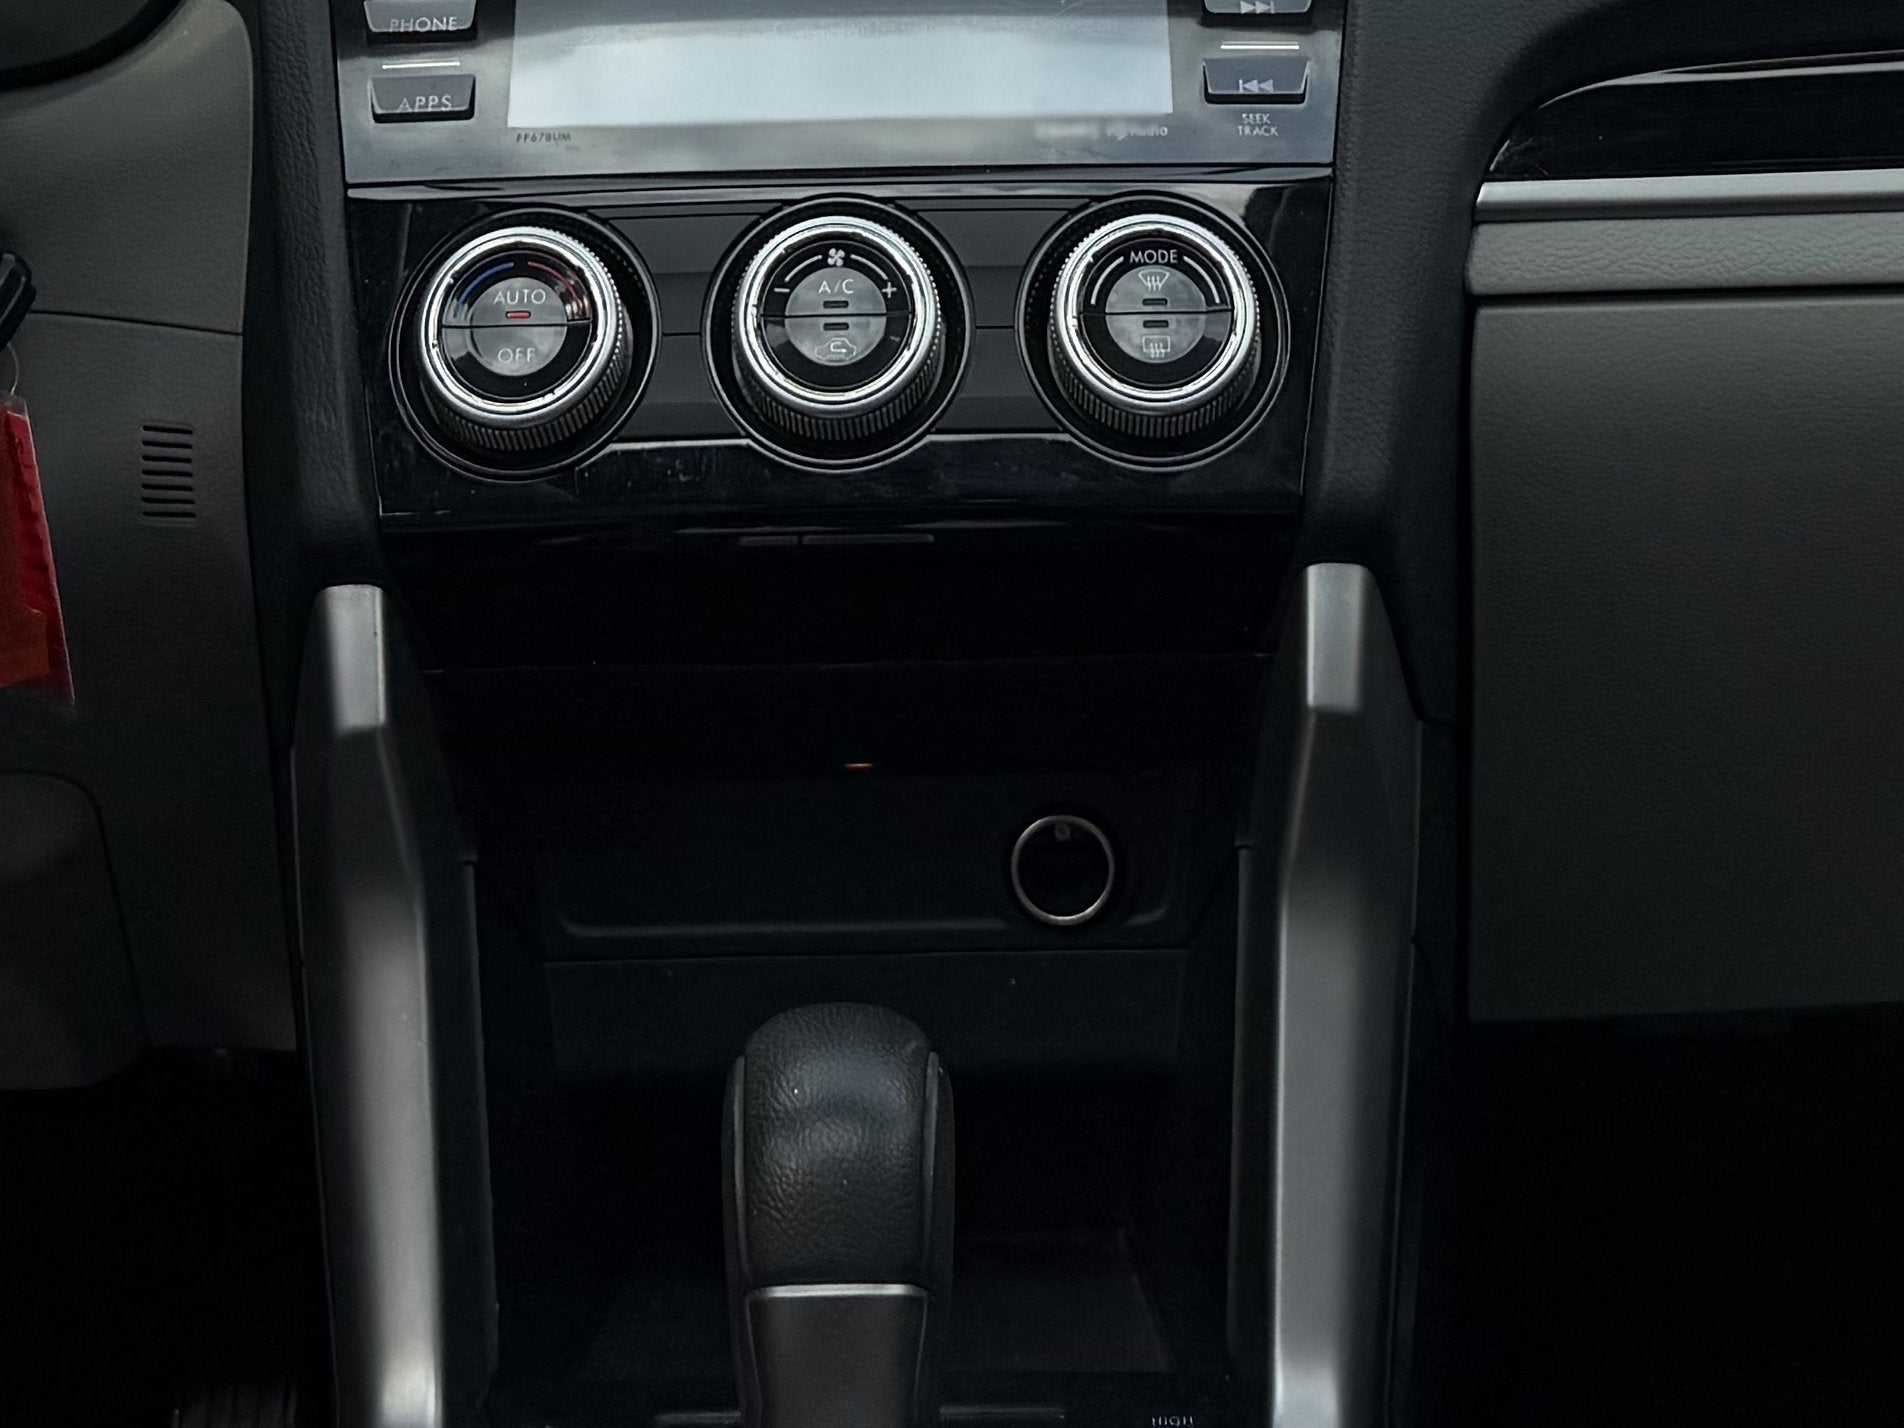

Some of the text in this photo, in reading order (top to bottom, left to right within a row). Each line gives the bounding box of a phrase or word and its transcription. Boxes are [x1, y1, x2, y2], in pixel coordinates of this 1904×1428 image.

[389, 15, 458, 33] PHONE
[398, 94, 454, 113] APPS
[1241, 113, 1271, 124] SEEK
[1237, 124, 1279, 137] TRACK
[1128, 246, 1180, 266] MODE
[492, 286, 547, 307] AUTO
[817, 276, 855, 298] A/C
[496, 344, 536, 366] OFF
